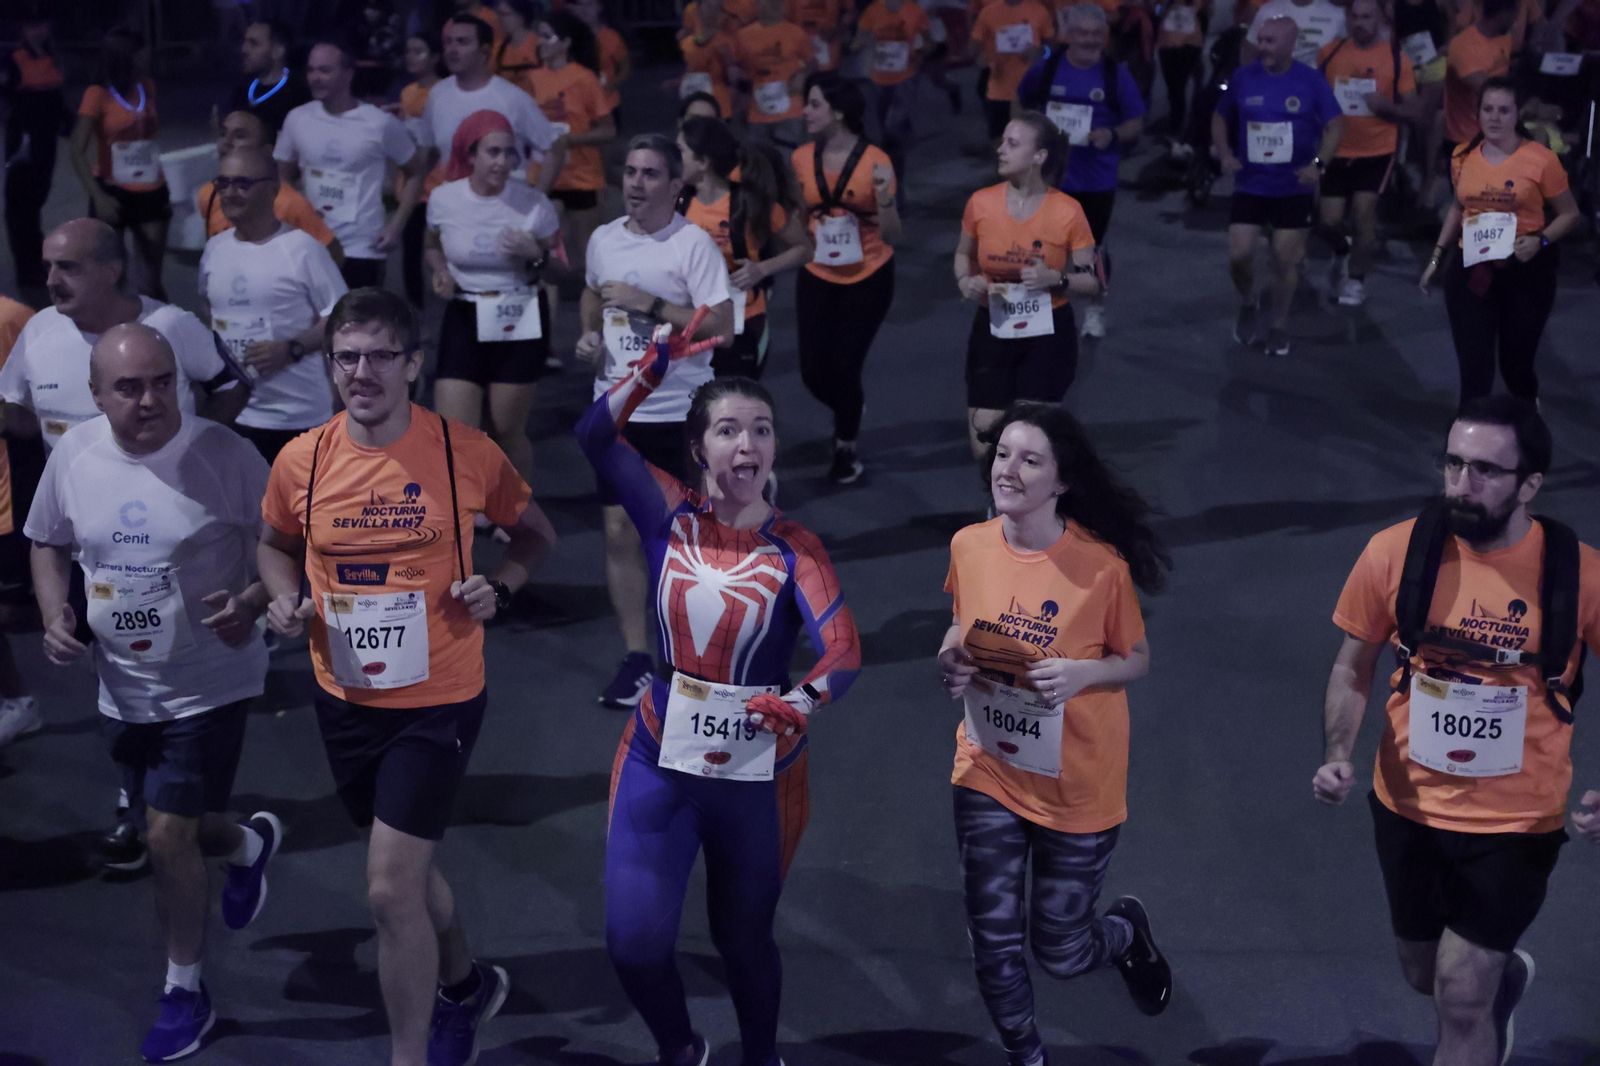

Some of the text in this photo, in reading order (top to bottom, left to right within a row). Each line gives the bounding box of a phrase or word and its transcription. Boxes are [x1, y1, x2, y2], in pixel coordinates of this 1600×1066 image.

[1473, 228, 1504, 242] 10487
[1003, 300, 1040, 315] 10966
[361, 506, 426, 516] NOCTURNA
[332, 518, 388, 528] SEVILLA
[112, 531, 150, 544] Cenit
[95, 561, 122, 572] Carrera
[111, 607, 161, 631] 2896
[972, 618, 1020, 640] SEVILLA
[998, 613, 1058, 637] NOCTURNA
[1459, 617, 1530, 637] NOCTURNA
[344, 625, 406, 650] 12677
[690, 712, 757, 741] 15419
[983, 705, 1041, 739] 18044
[1431, 711, 1503, 739] 18025
